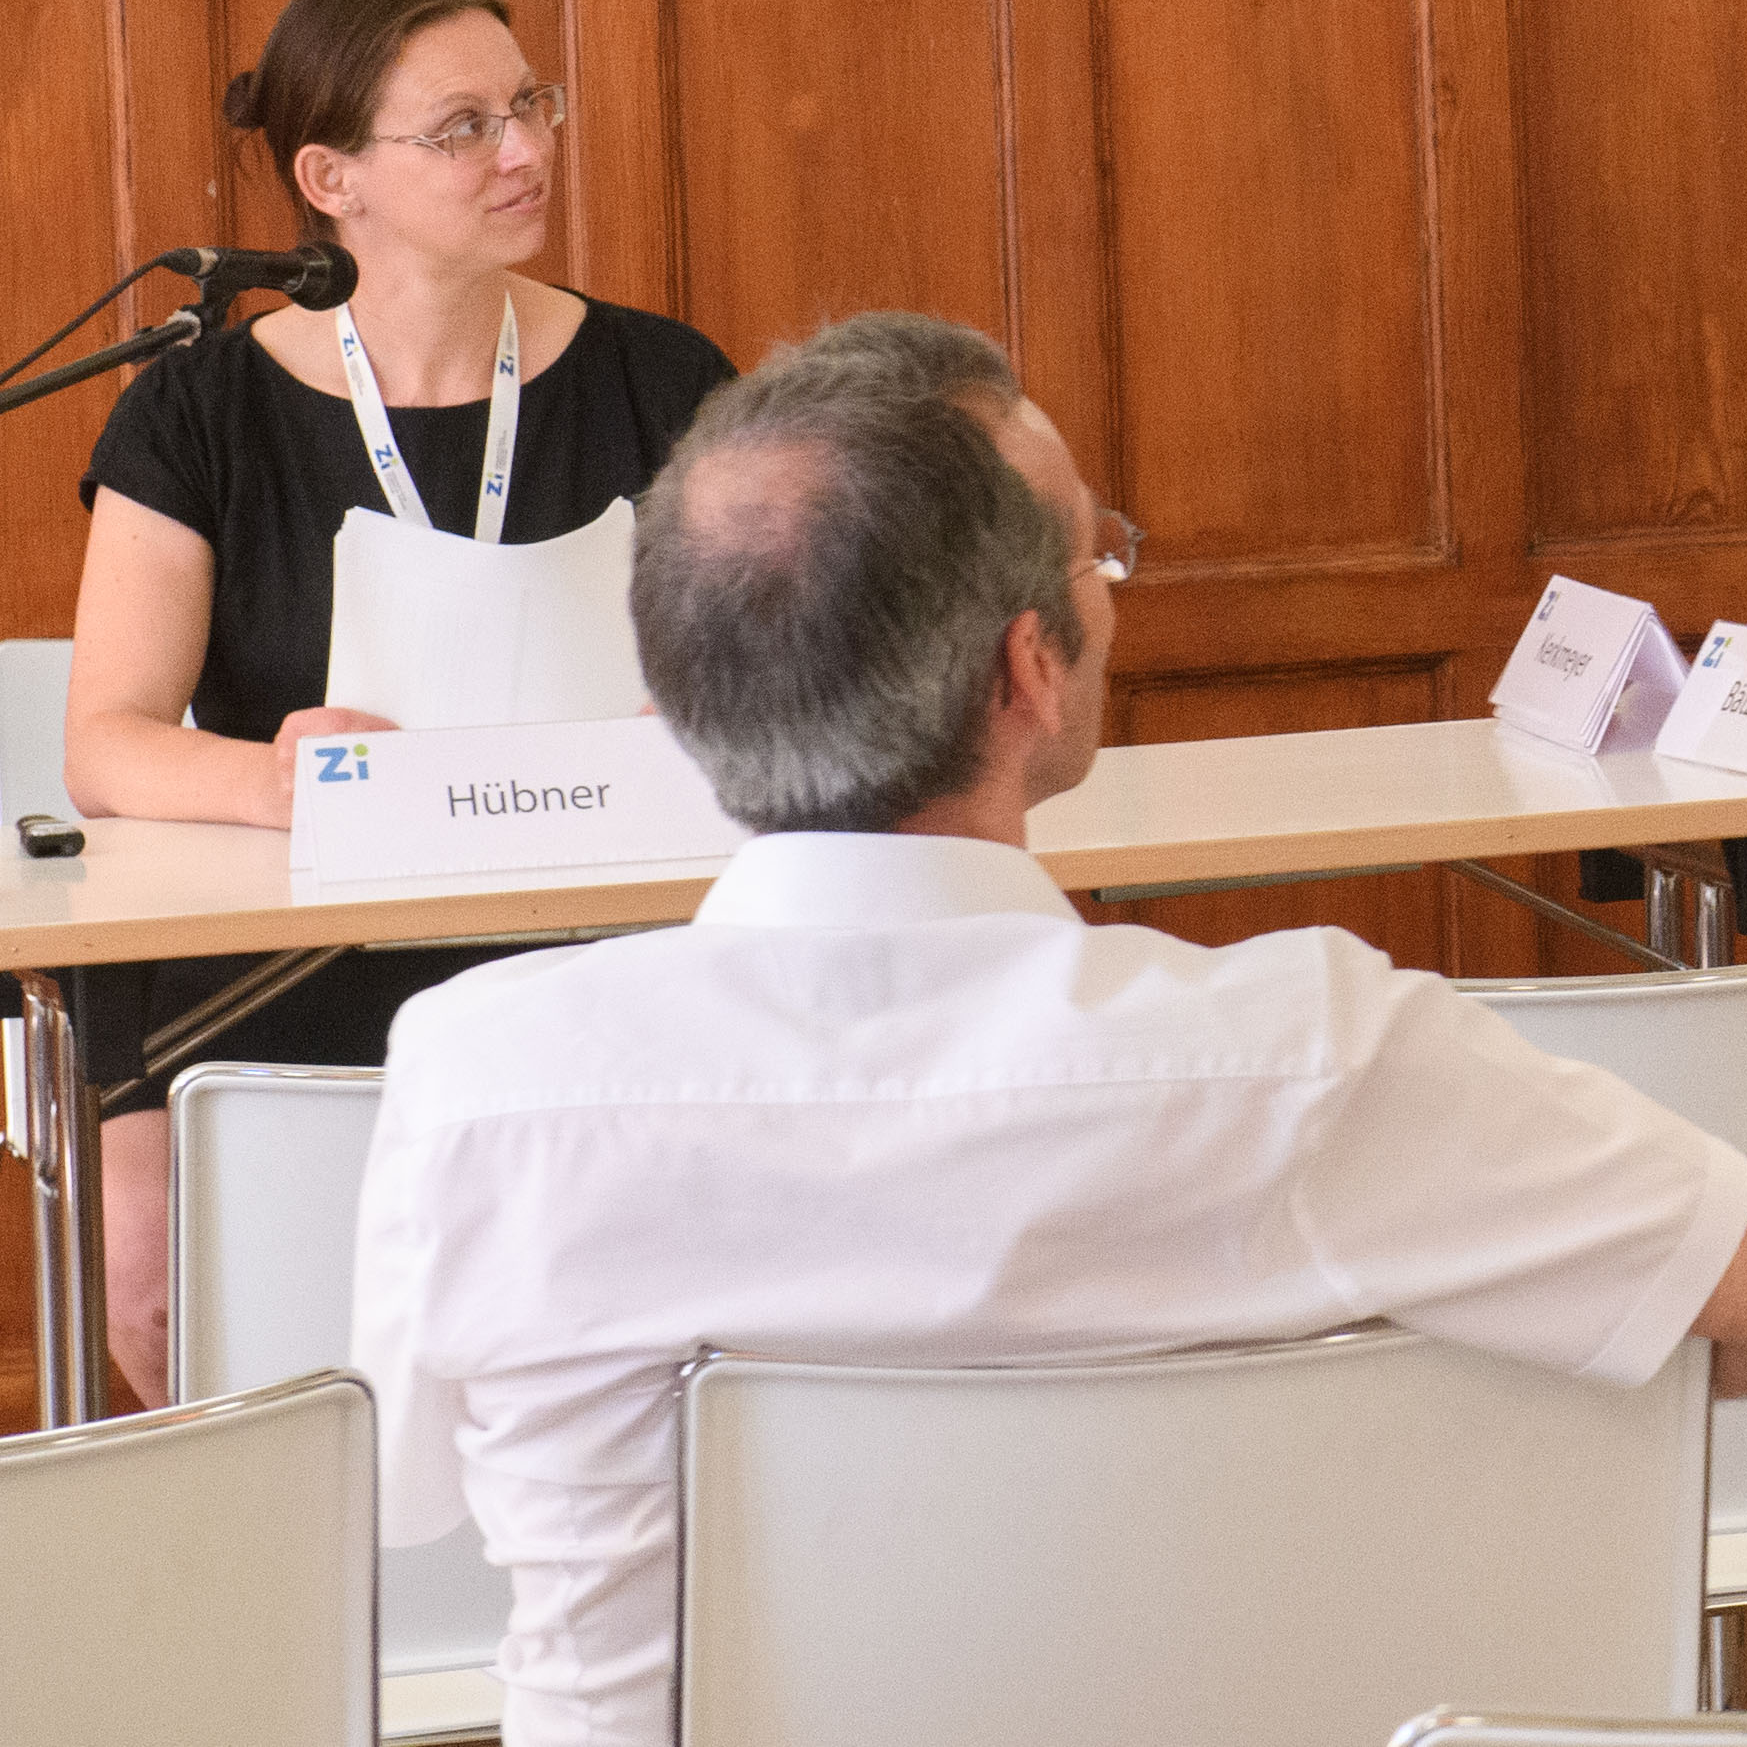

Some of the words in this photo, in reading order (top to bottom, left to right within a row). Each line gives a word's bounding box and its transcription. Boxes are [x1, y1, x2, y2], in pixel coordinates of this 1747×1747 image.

[1702, 637, 1733, 669] Zi
[314, 743, 369, 783] Zi
[448, 779, 610, 817] Hübner
